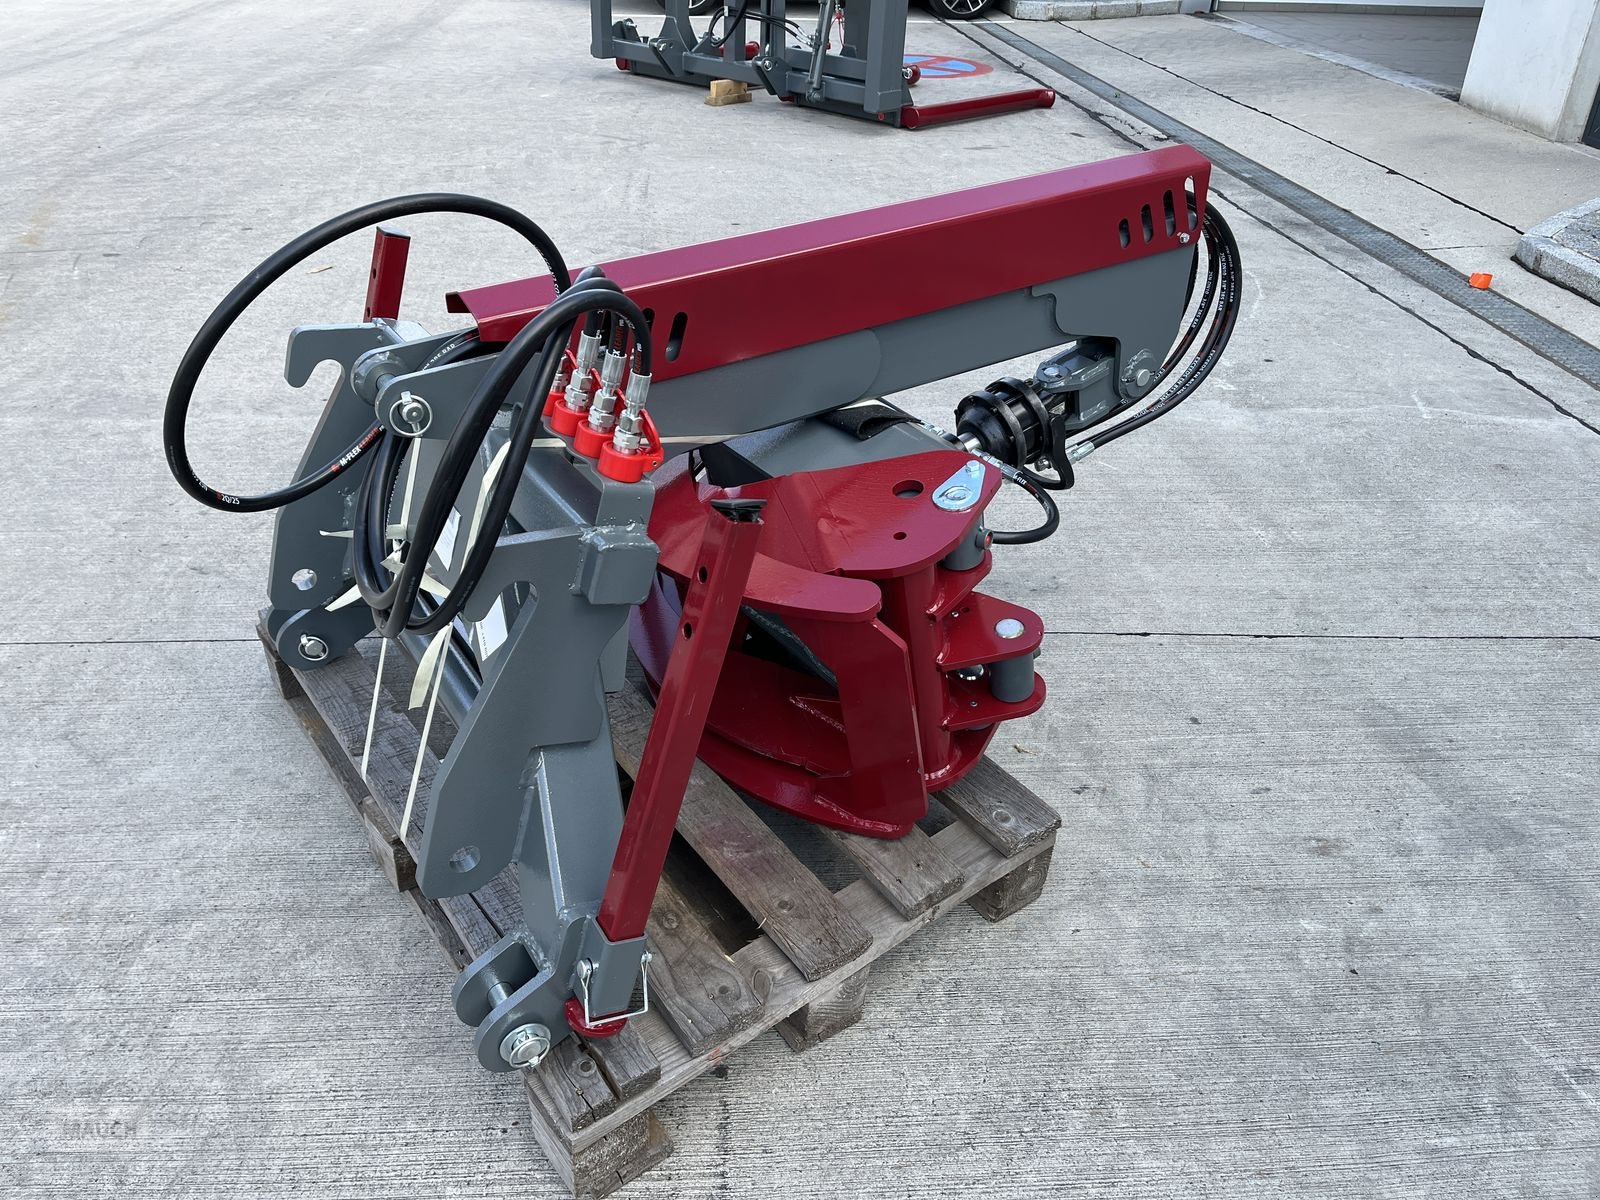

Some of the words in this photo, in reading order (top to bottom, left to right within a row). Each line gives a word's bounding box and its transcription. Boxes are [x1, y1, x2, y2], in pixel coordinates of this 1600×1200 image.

[1191, 318, 1199, 328] BAR
[1182, 355, 1201, 378] EXCEEDS
[340, 446, 361, 466] M-FLEX
